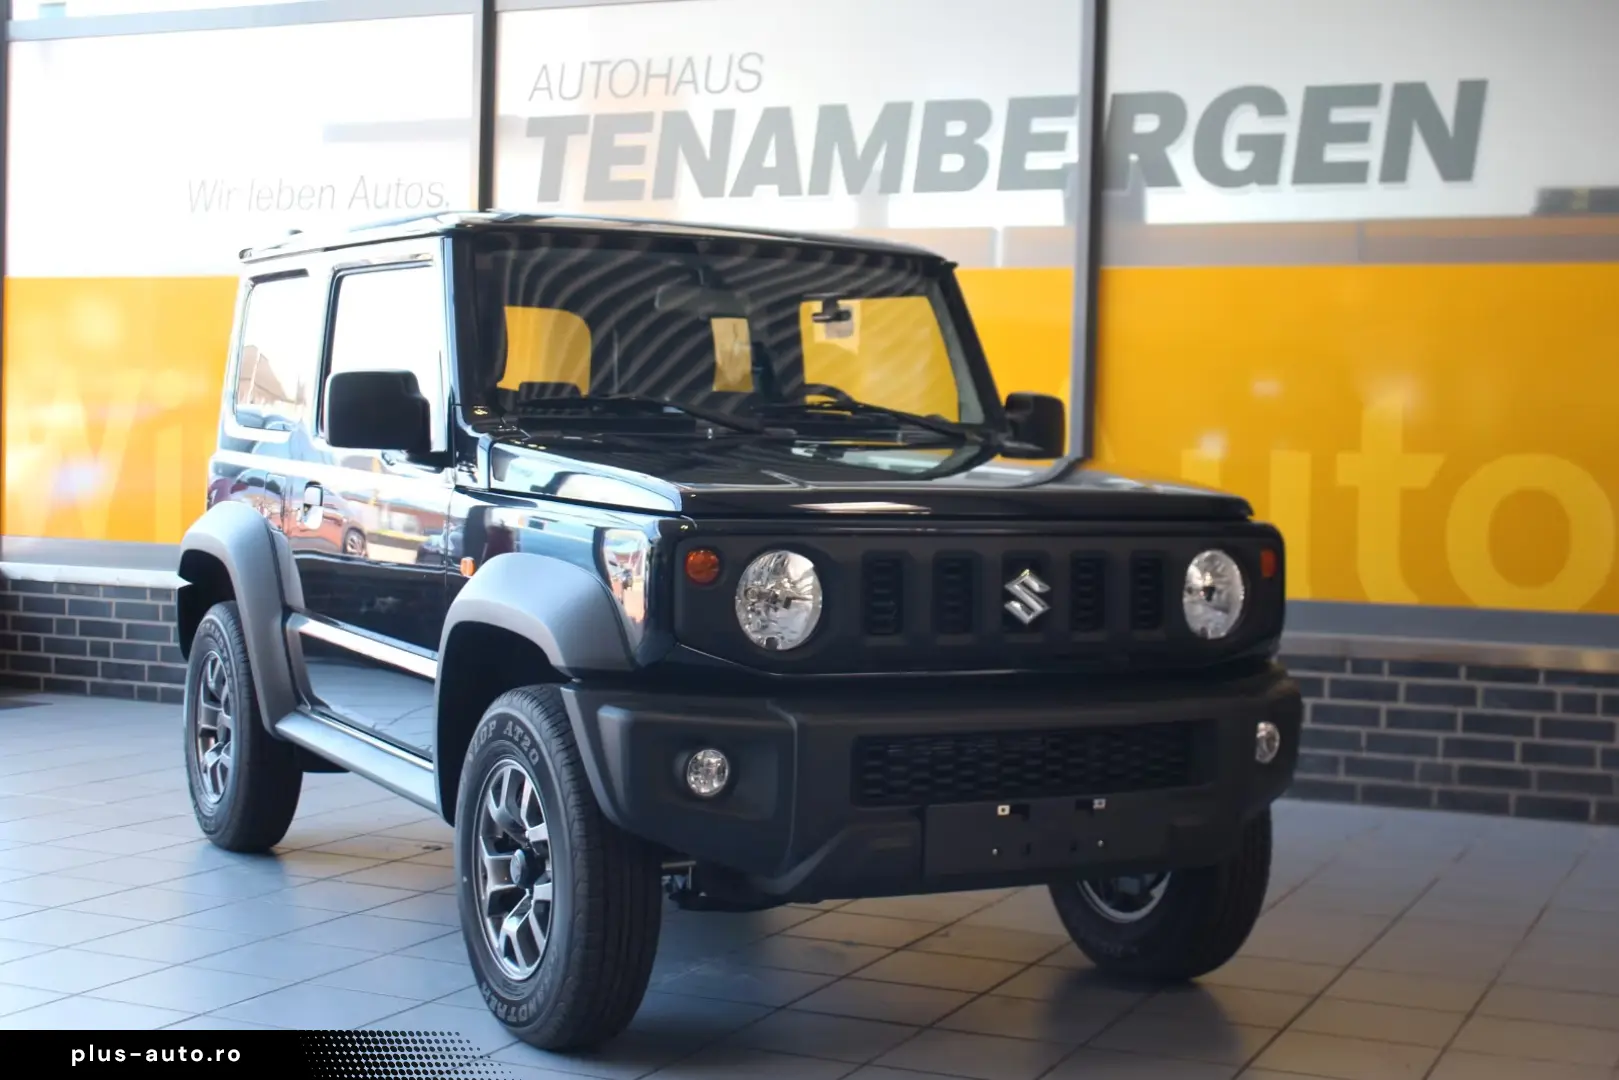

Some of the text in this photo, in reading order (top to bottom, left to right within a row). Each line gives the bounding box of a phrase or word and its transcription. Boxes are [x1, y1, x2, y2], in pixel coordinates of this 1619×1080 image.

[530, 52, 764, 101] AUTOHAUS
[526, 79, 1489, 202] TENAMBERGEN
[188, 175, 450, 213] Wir leben Autos.
